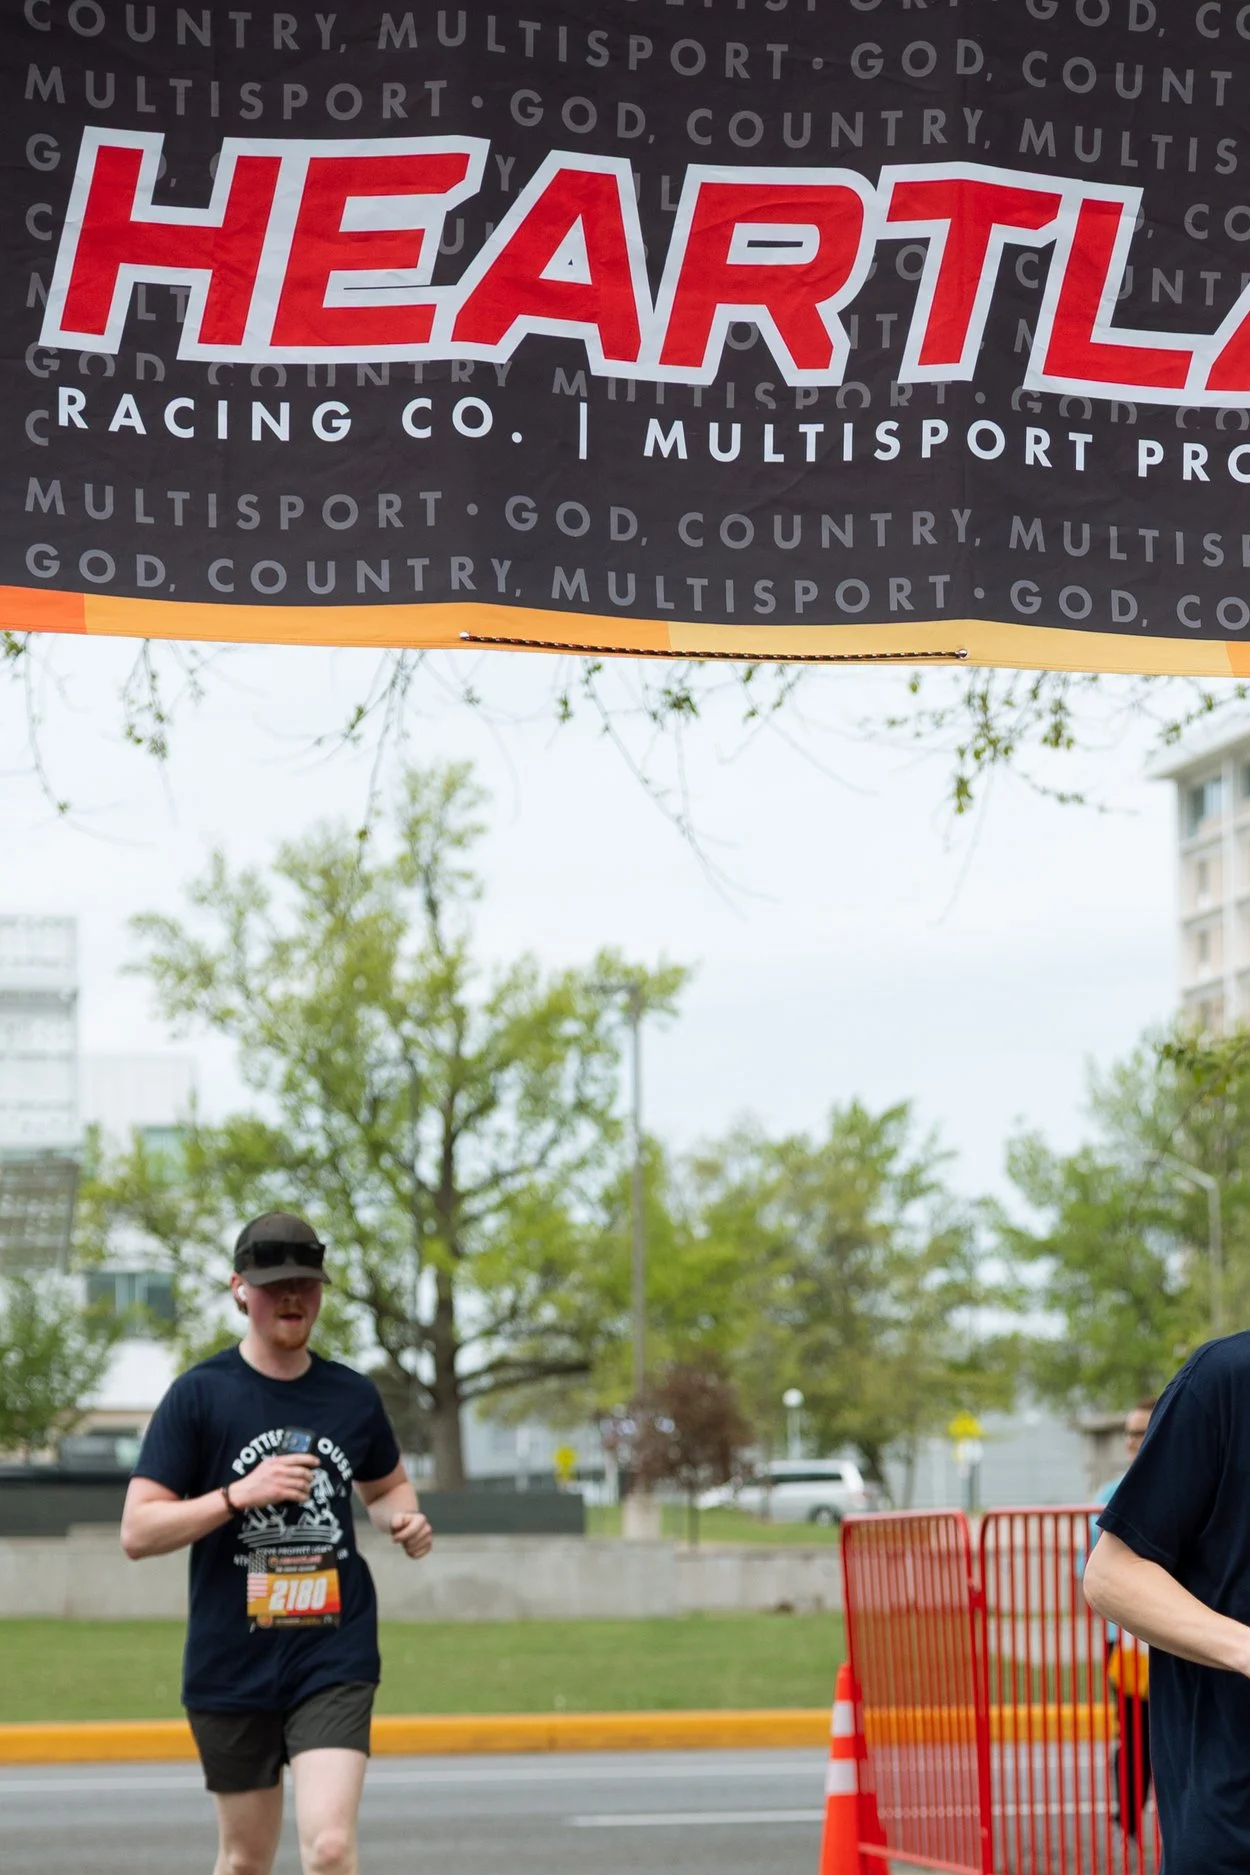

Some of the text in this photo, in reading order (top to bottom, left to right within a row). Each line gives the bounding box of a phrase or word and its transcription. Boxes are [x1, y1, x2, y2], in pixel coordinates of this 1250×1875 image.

[24, 0, 347, 53] COUNTRY,
[377, 9, 789, 80] MULTISPORT
[849, 39, 992, 82] GOD,
[1025, 0, 1165, 37] GOD,
[24, 63, 448, 121] MULTISPORT
[509, 88, 656, 145] GOD,
[686, 107, 991, 149] COUNTRY,
[58, 386, 352, 442] RACING
[401, 396, 523, 444] CO.
[643, 417, 1093, 471] MULTISPORT
[24, 476, 442, 530] MULTISPORT
[504, 494, 647, 547] GOD,
[678, 508, 981, 549] COUNTRY,
[25, 542, 176, 592] GOD,
[207, 556, 521, 598] COUNTRY,
[550, 565, 951, 614] MULTISPORT
[1009, 579, 1148, 627] GOD,
[317, 1437, 354, 1482] OUSE
